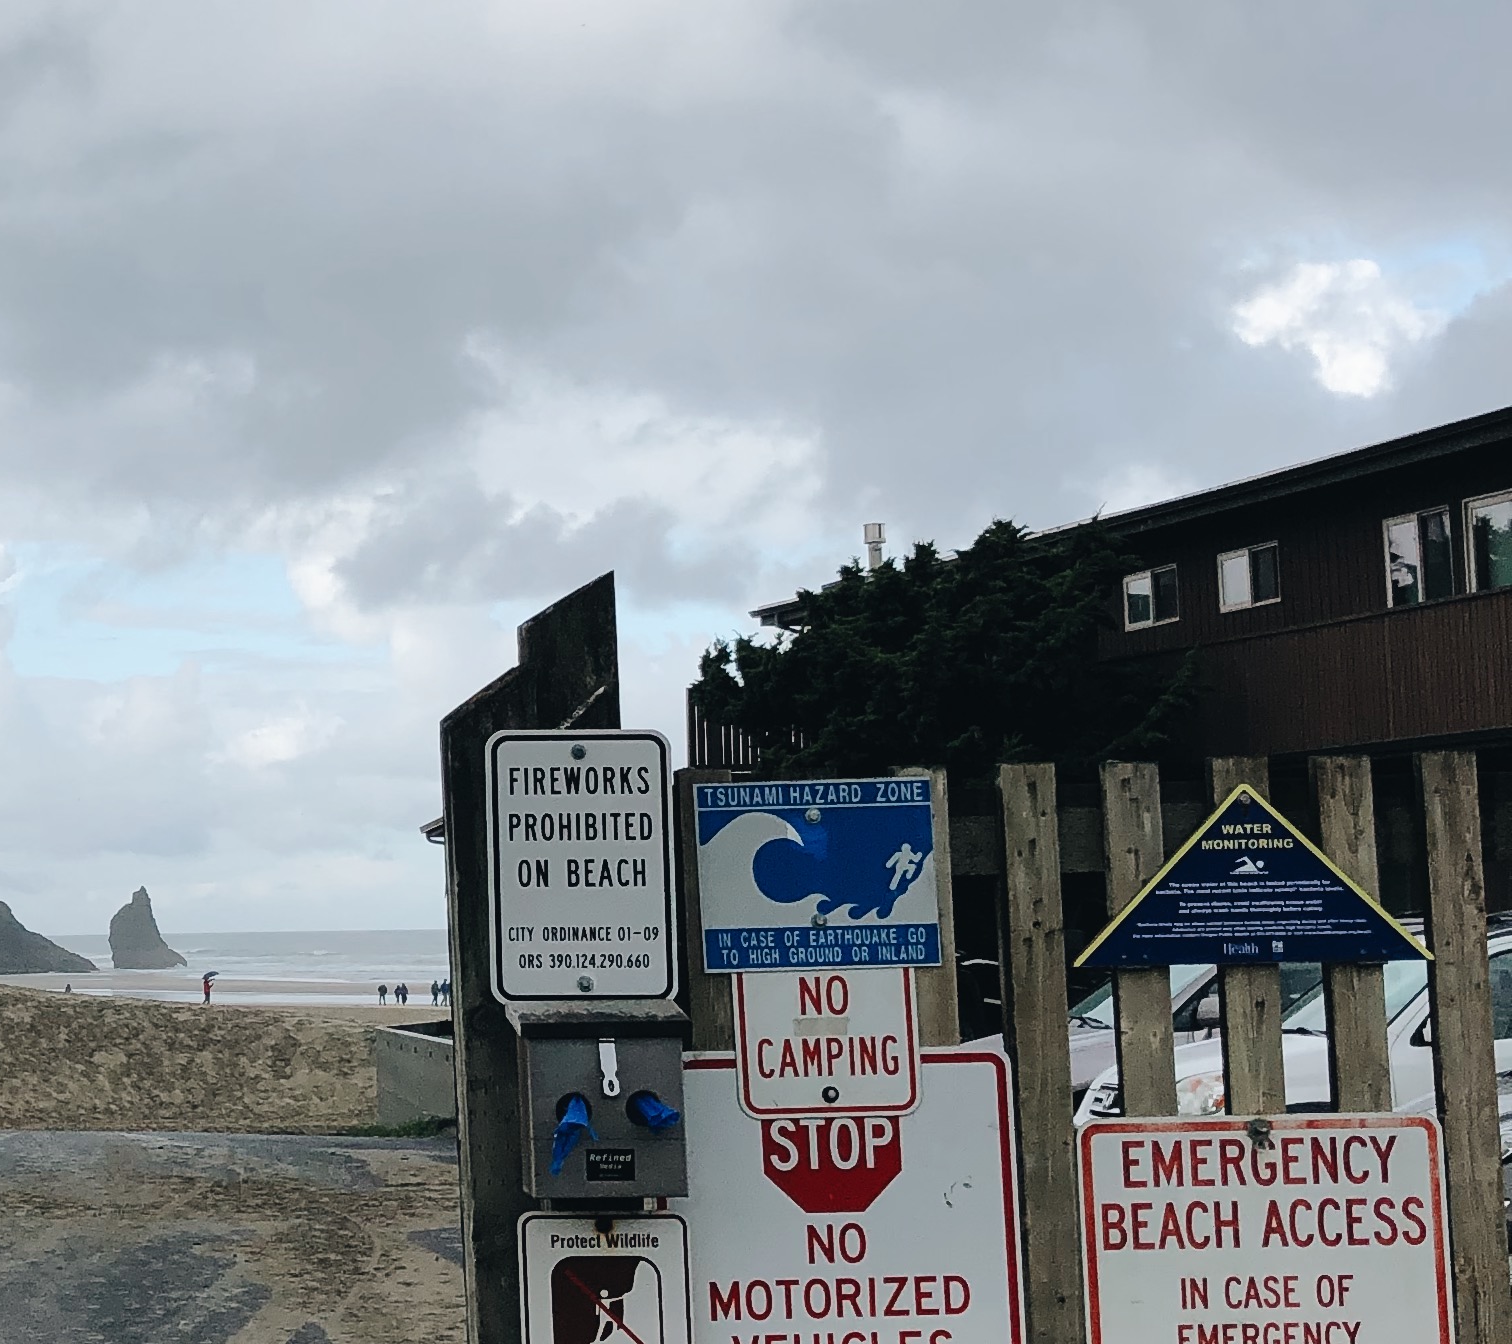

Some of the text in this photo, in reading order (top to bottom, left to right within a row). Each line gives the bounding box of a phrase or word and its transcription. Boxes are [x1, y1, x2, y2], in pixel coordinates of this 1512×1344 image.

[508, 766, 650, 796] FIREWORKS
[704, 782, 924, 806] TSUNAMI HAZARD ZONE
[508, 812, 653, 842] PROHIBITED
[1221, 822, 1272, 835] WATER
[1201, 838, 1294, 851] MONITORING
[517, 858, 647, 888] ON BEACH
[508, 926, 660, 942] CITY ORDINANCE 01-09
[718, 927, 926, 948] IN CASE OF EARTHQUAKE GO
[518, 953, 650, 969] ORS 390.124.290.660
[721, 944, 926, 965] TO HIGH GROUND OR INLAND
[798, 975, 849, 1016] NO
[756, 1035, 900, 1079] CAMPING
[589, 1153, 632, 1162] Refined
[769, 1117, 894, 1172] STOP
[1121, 1135, 1398, 1189] EMERGENCY
[1101, 1196, 1427, 1251] BEACH ACCESS
[550, 1233, 660, 1249] Protect Wildlife
[806, 1222, 867, 1265] NO
[708, 1275, 971, 1322] MOTORIZED
[1180, 1274, 1354, 1310] IN CASE OF
